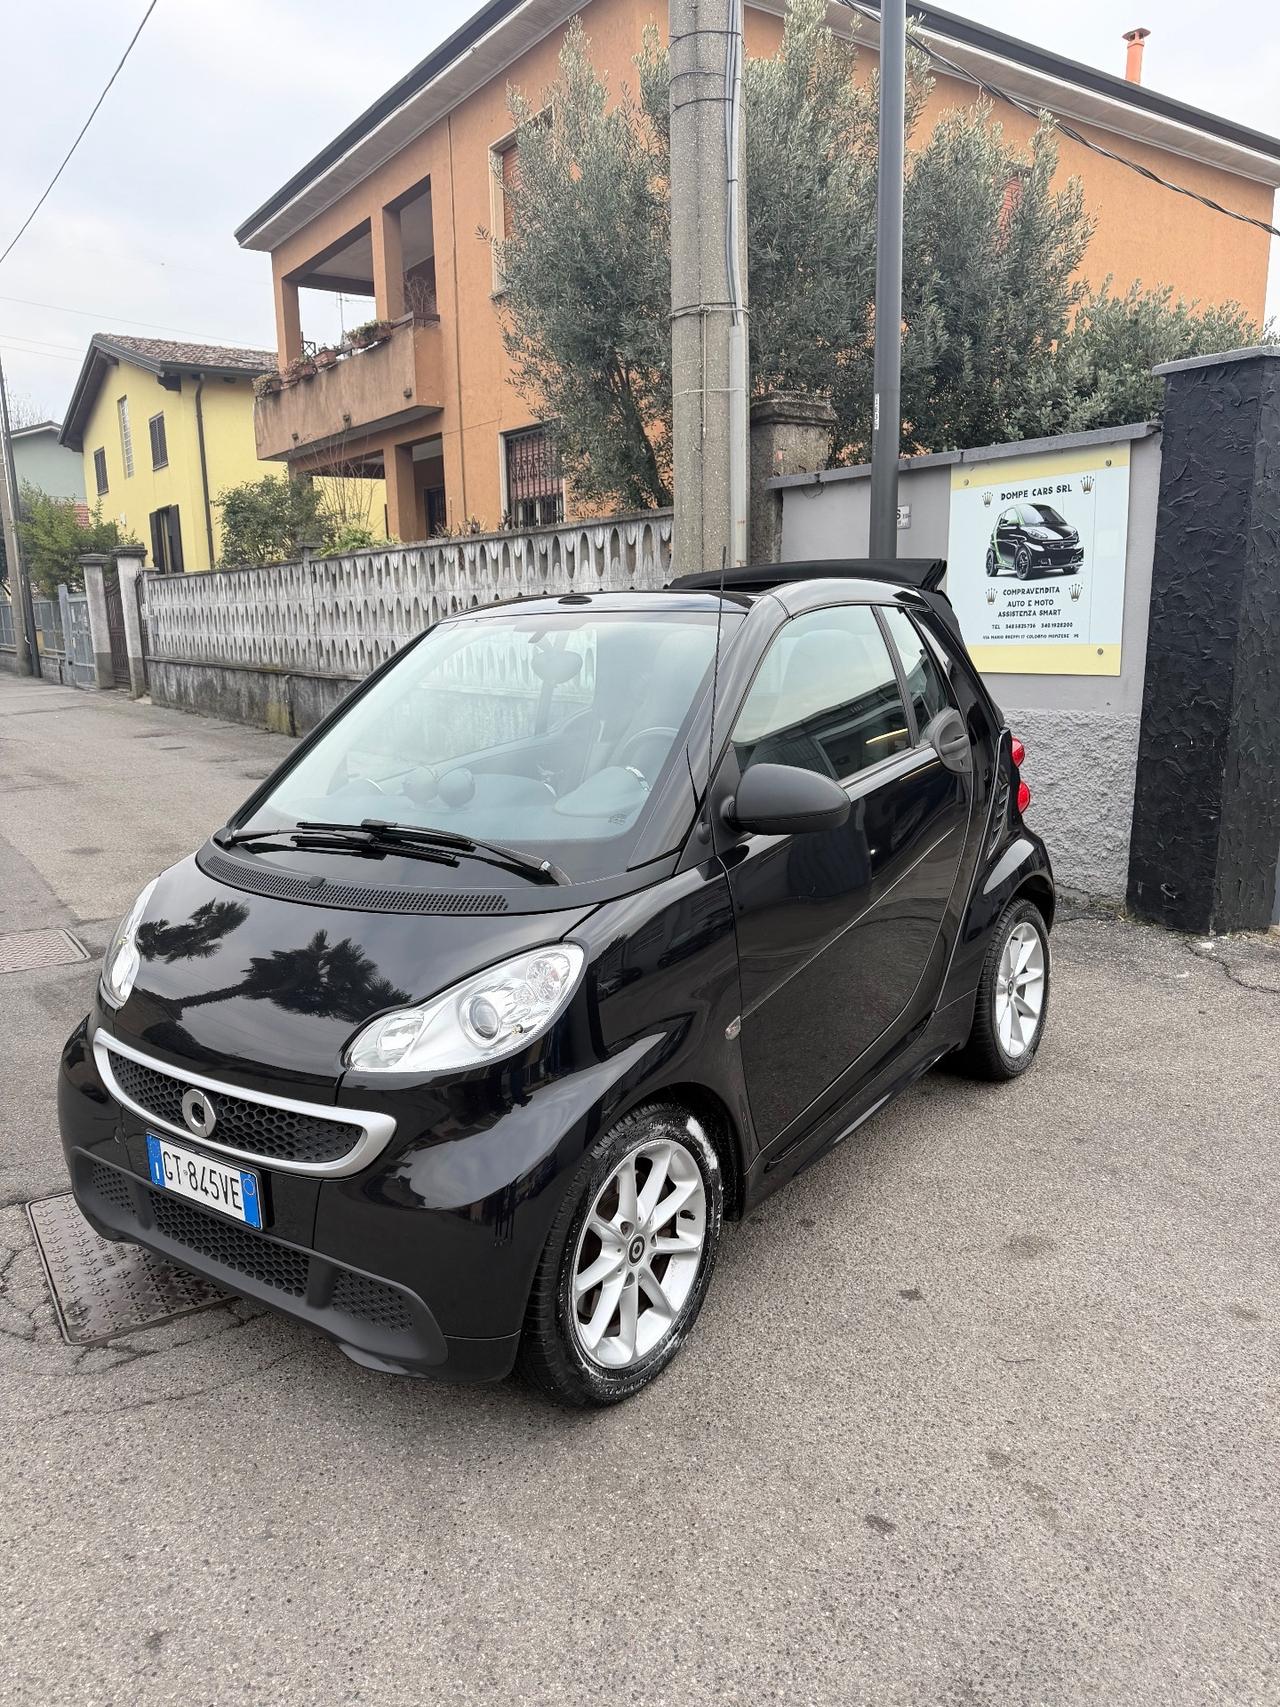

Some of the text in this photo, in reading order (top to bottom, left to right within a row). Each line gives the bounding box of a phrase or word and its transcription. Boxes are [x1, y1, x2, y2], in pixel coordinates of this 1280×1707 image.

[1001, 484, 1072, 501] DOMPE CARS SRL
[1003, 587, 1060, 595] COMPRAVENDITA
